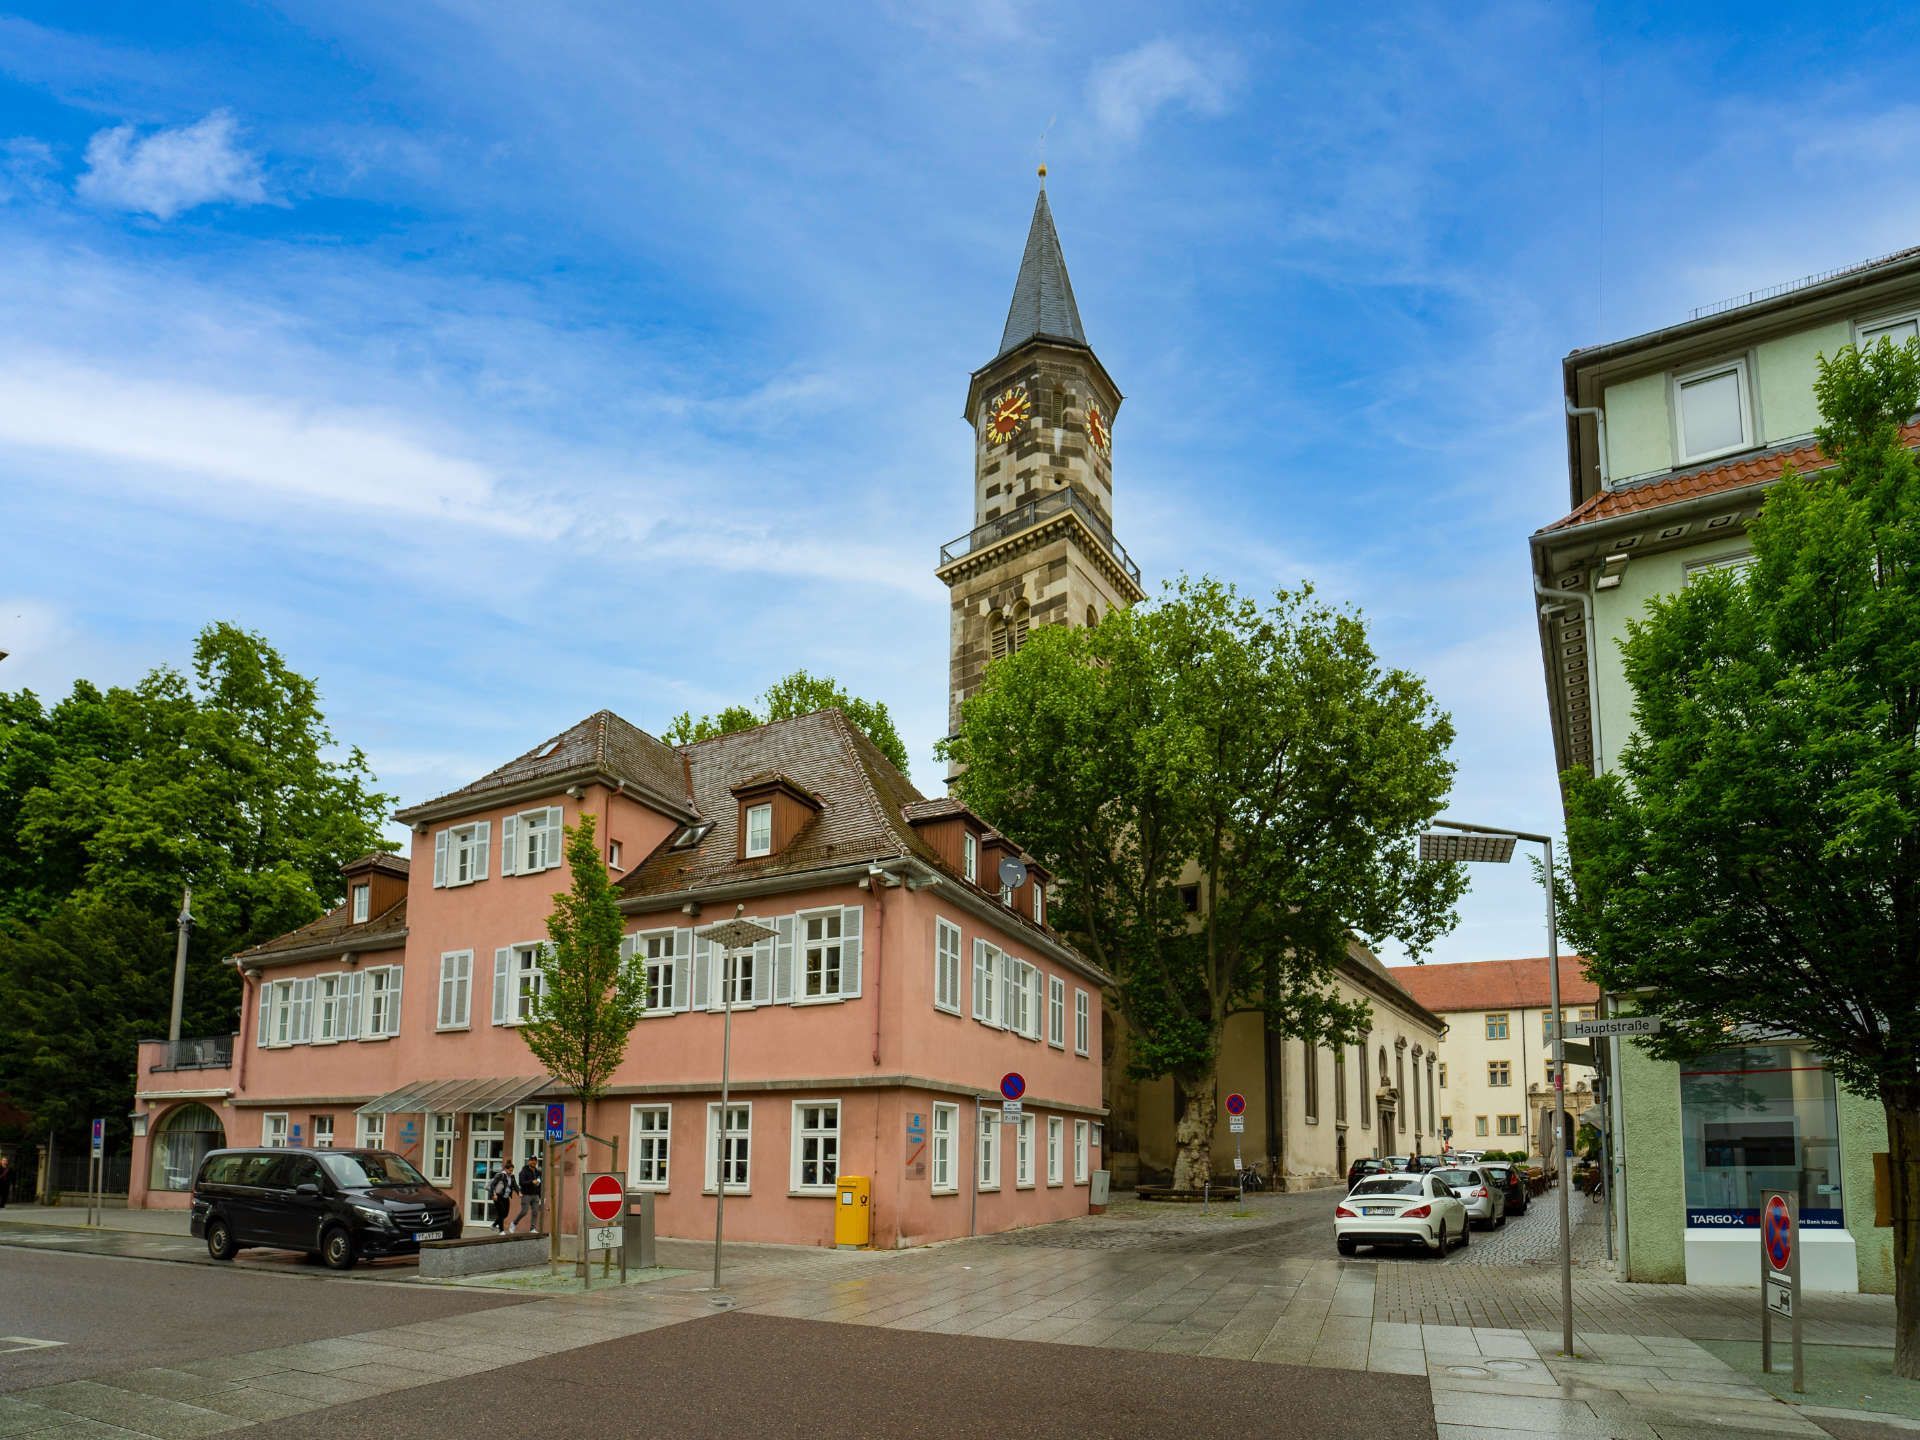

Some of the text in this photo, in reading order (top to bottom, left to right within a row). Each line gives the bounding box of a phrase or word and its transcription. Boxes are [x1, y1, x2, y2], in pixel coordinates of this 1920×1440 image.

[1575, 1020, 1650, 1035] Hauptstraße
[548, 1130, 562, 1139] TAXI
[1691, 1215, 1732, 1224] TARGO
